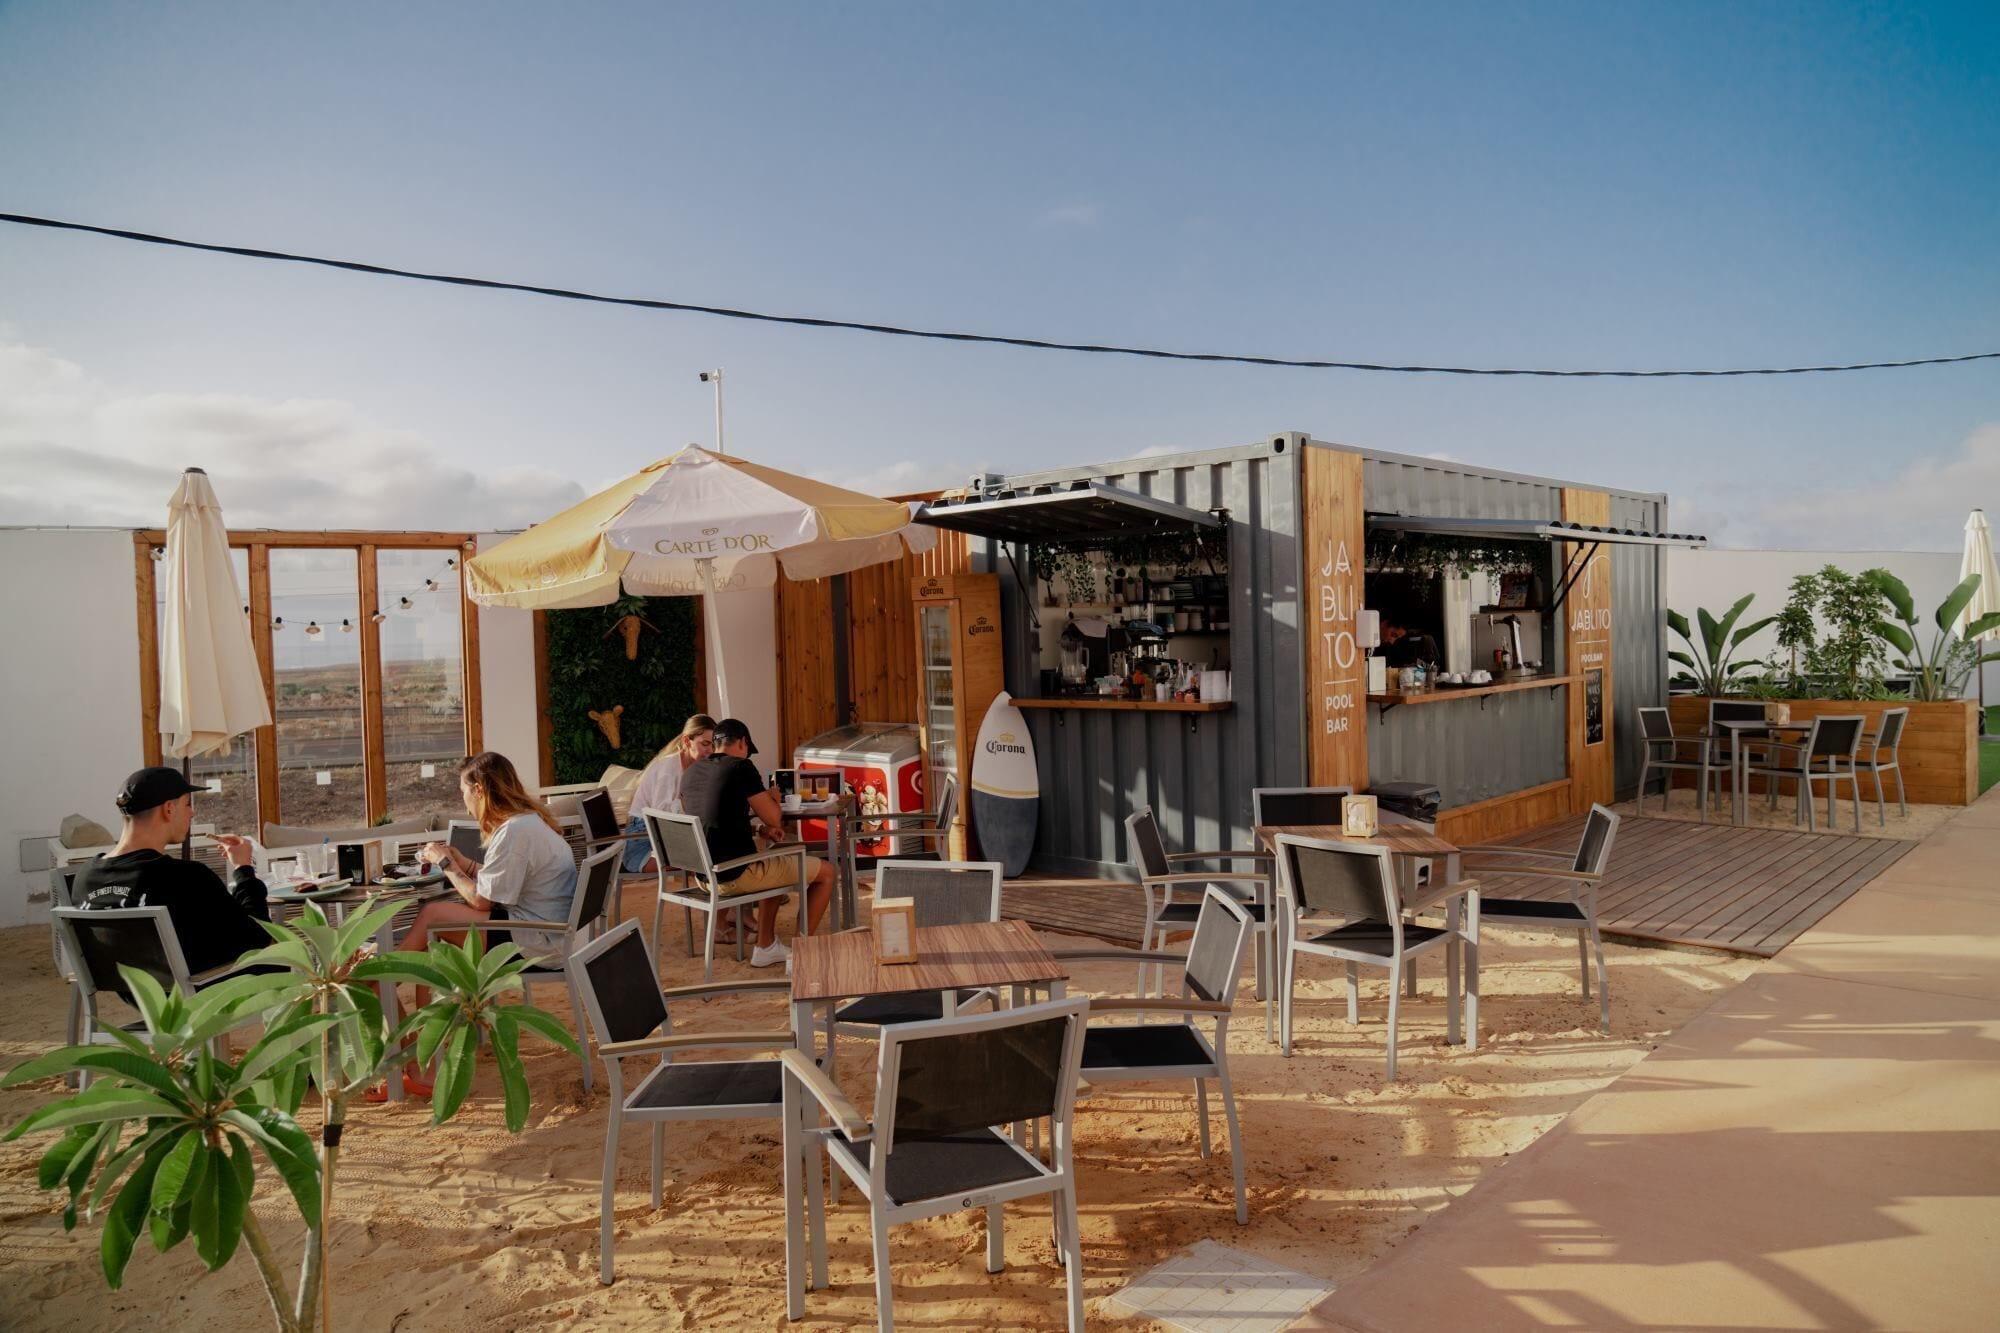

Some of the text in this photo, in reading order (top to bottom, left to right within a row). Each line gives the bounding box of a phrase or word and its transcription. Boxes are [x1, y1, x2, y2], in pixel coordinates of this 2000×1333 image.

[655, 534, 775, 554] CARTE D'OR
[1321, 540, 1352, 577] JA
[920, 586, 944, 596] Corona
[1321, 584, 1353, 621] BLI
[1571, 608, 1611, 632] JABLITO
[968, 624, 994, 635] Corona
[1323, 631, 1356, 669] TO
[1325, 694, 1355, 711] POOL
[1326, 717, 1348, 734] BAR
[986, 740, 1025, 754] Corona
